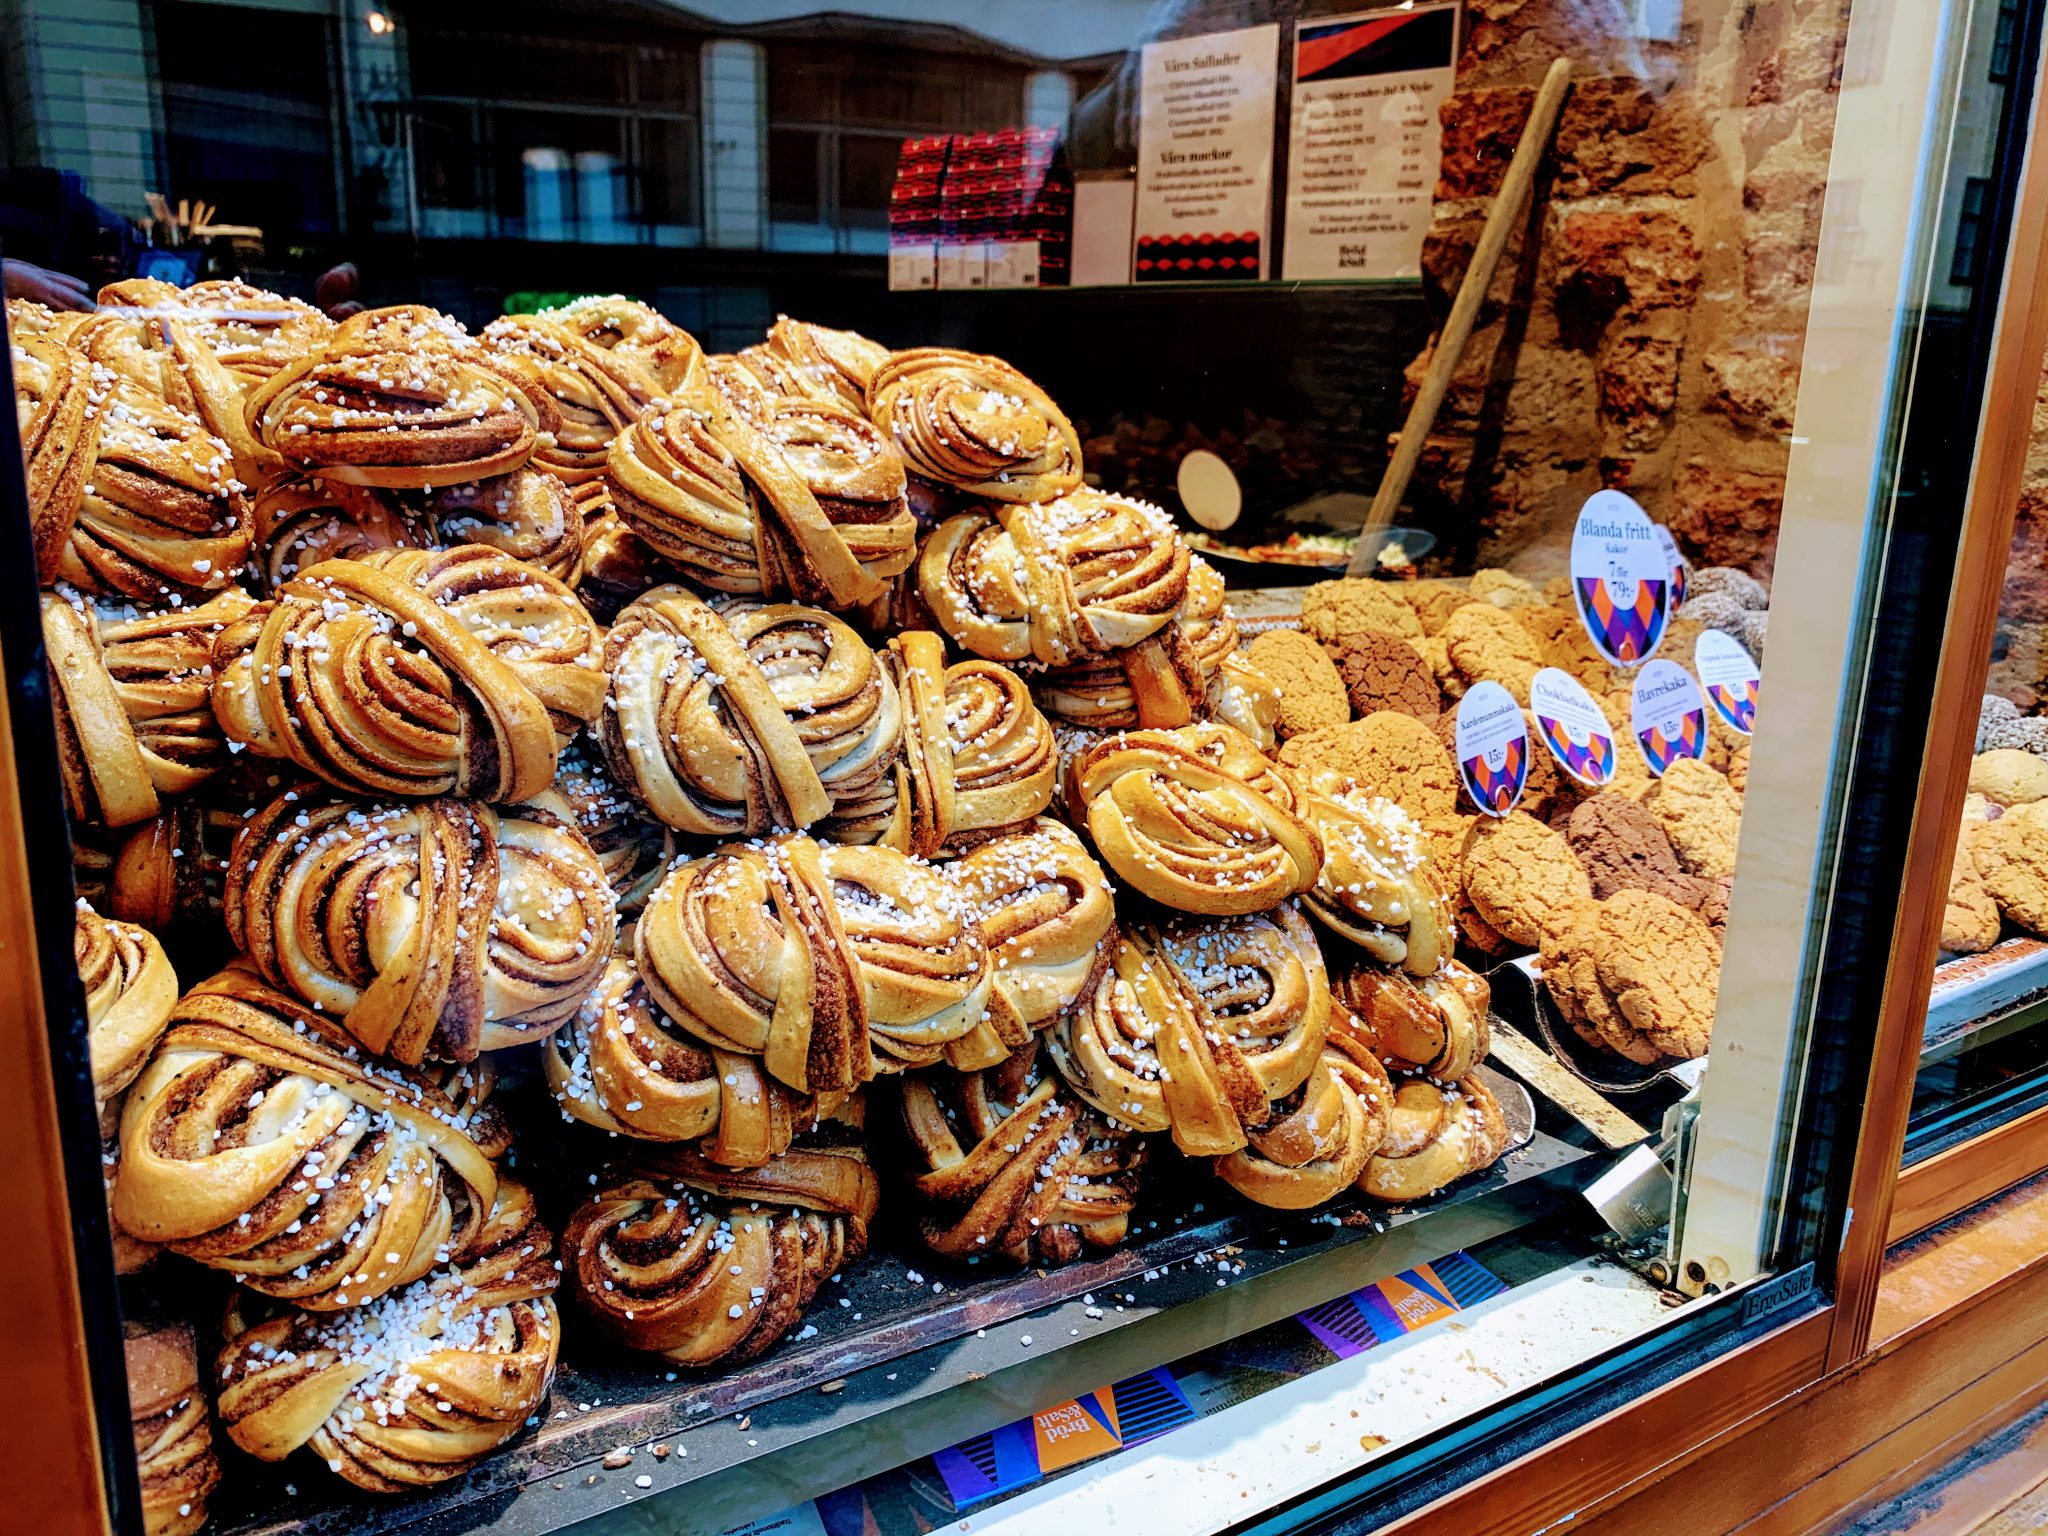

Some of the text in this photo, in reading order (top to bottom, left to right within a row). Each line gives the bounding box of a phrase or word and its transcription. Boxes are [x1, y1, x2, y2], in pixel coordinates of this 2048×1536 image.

[1581, 519, 1652, 540] Blanda fritt
[1608, 561, 1616, 577] 7
[1611, 581, 1635, 598] 79:-
[1638, 676, 1687, 703] Havrekaka
[1488, 748, 1504, 764] 15:-
[1395, 1290, 1427, 1313] &Salt
[1747, 1270, 1811, 1317] ErgoSafe
[1407, 1300, 1438, 1325] Bröd
[1037, 1404, 1081, 1428] &Salt
[1044, 1417, 1091, 1443] Bröd
